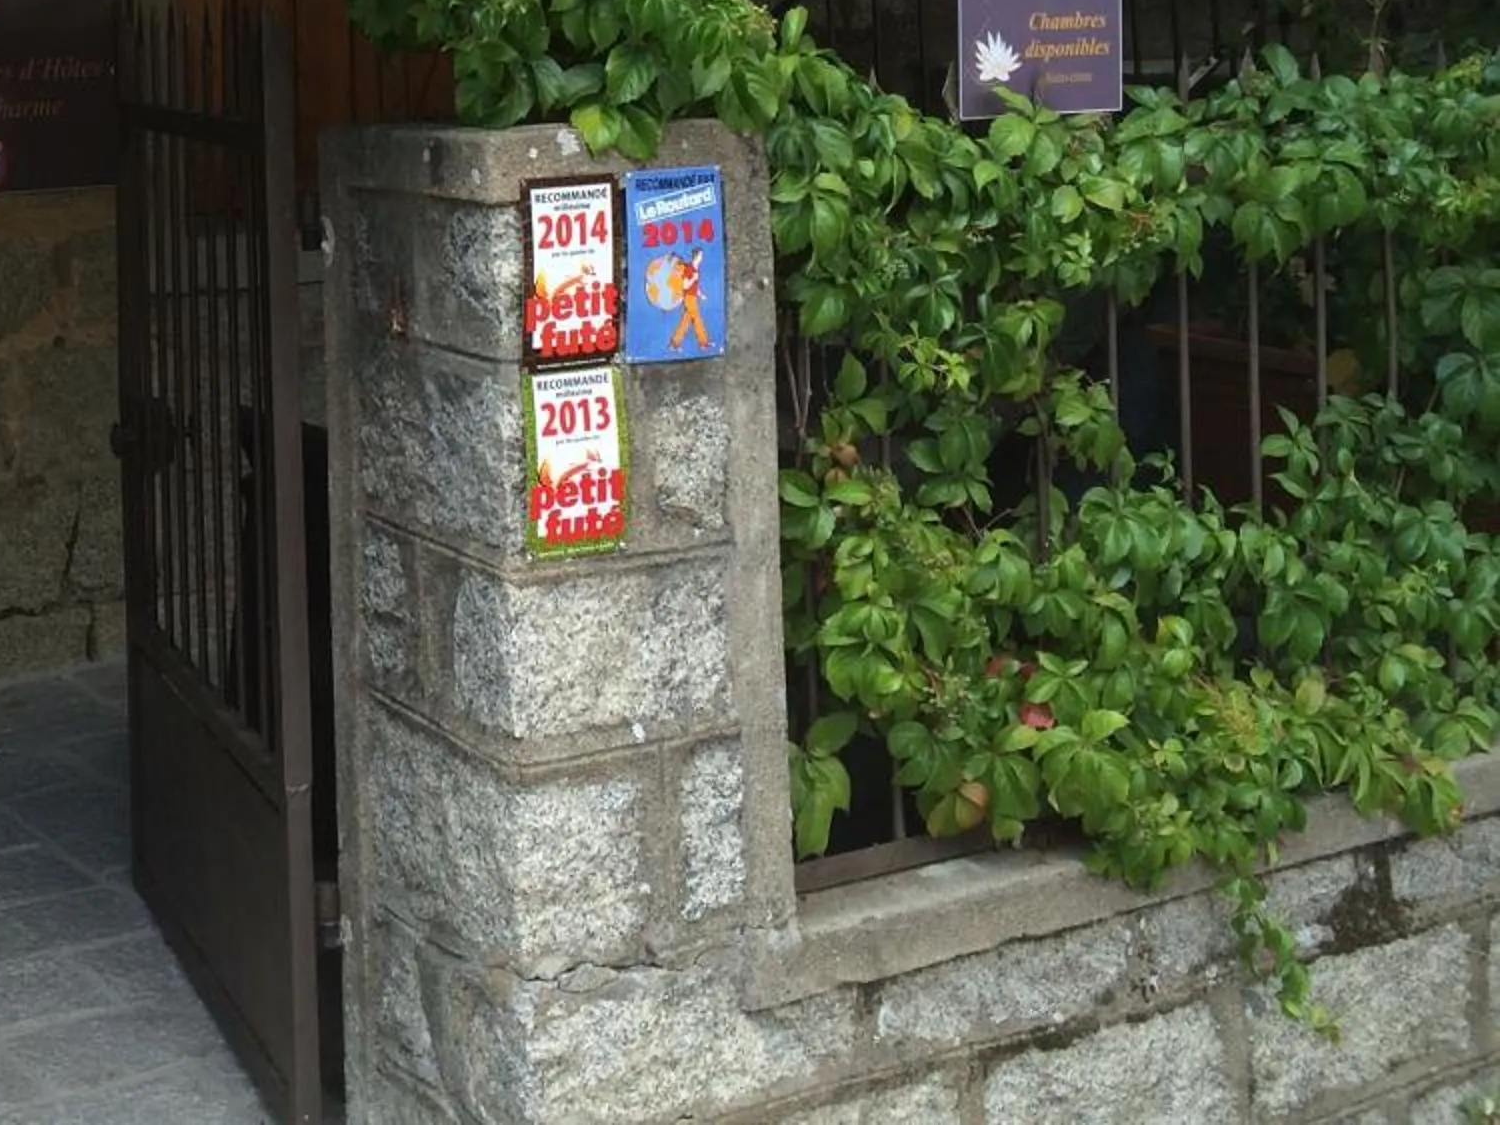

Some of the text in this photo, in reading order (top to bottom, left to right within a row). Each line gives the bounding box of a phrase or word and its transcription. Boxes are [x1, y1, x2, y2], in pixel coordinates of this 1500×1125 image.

[1029, 11, 1107, 31] Chambres
[1025, 38, 1111, 63] disponibles
[538, 209, 608, 250] 2014
[642, 218, 714, 248] 2014
[525, 280, 619, 332] petit
[539, 318, 618, 357] futé
[541, 396, 611, 437] 2013
[529, 466, 627, 521] petit
[545, 505, 626, 546] futé
